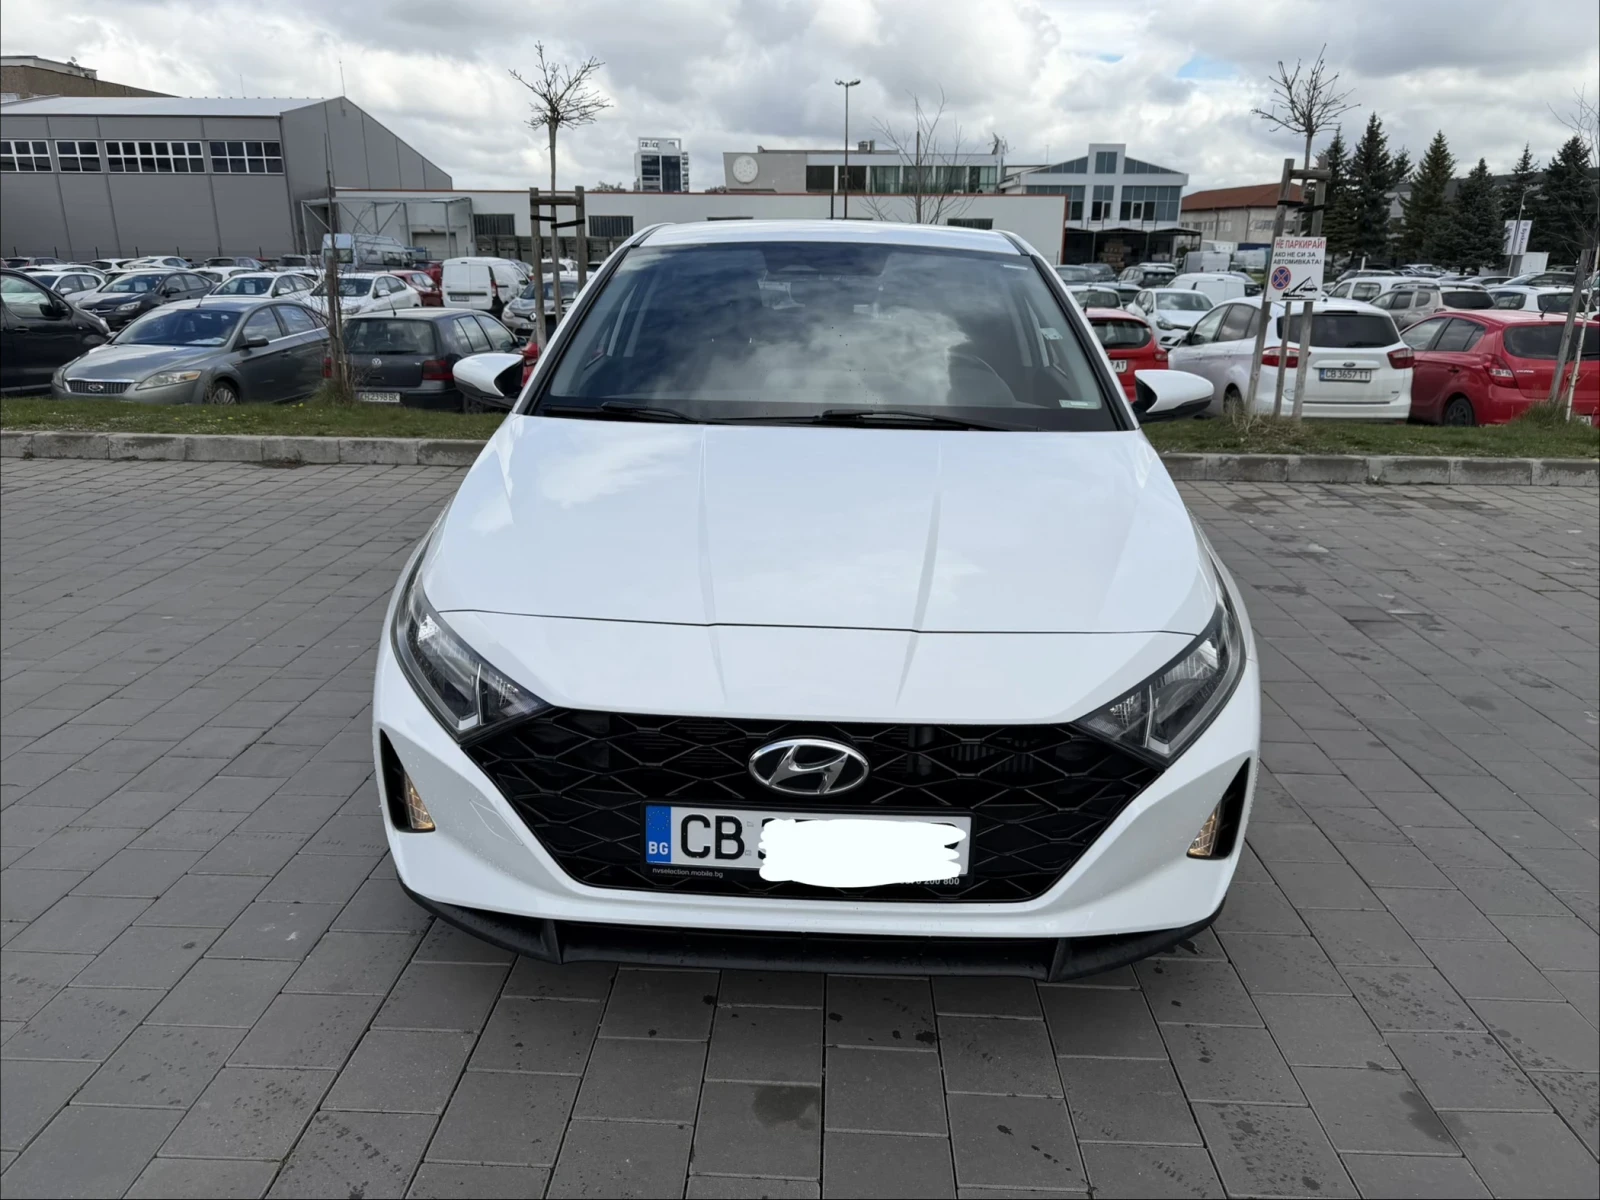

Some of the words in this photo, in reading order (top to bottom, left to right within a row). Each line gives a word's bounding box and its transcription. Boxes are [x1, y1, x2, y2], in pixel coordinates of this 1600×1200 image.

[1276, 240, 1284, 249] НЕ
[1286, 239, 1326, 249] ПАРКИРАЙ!
[1326, 370, 1336, 378] CB
[1337, 370, 1357, 379] 3657
[681, 814, 745, 860] CB
[648, 841, 669, 855] BG
